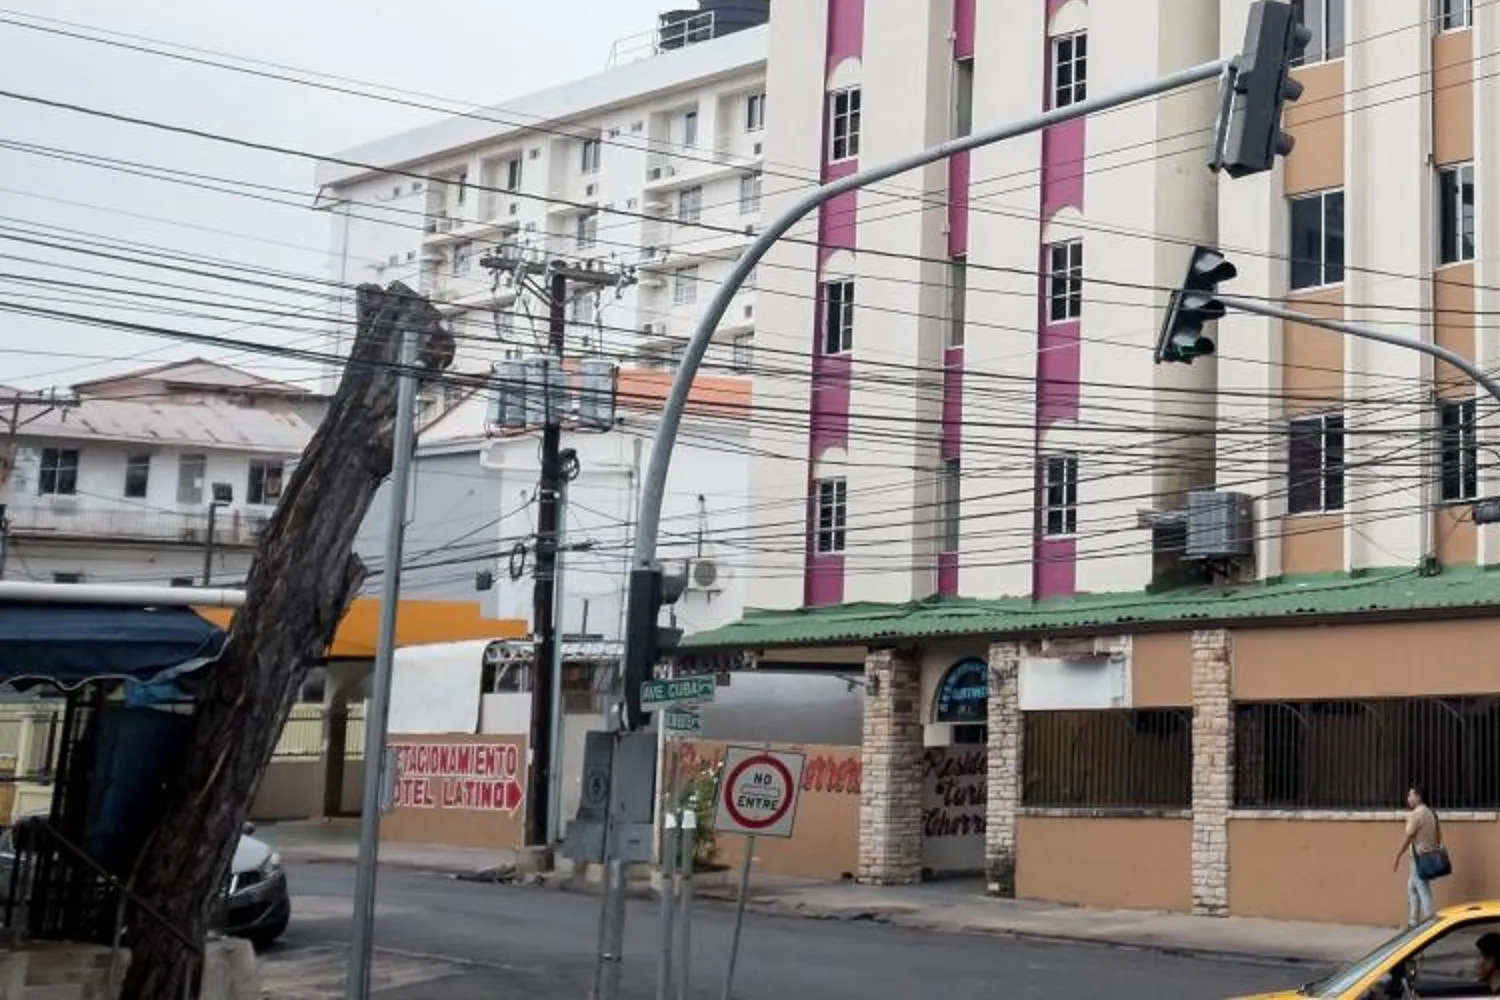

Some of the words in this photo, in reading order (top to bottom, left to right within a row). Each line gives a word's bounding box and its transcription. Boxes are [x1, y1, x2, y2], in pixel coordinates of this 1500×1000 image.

[642, 683, 666, 701] AVE
[667, 680, 699, 698] CUBA
[753, 771, 773, 784] NO
[442, 779, 504, 811] LATINO
[737, 795, 780, 811] ENTRE
